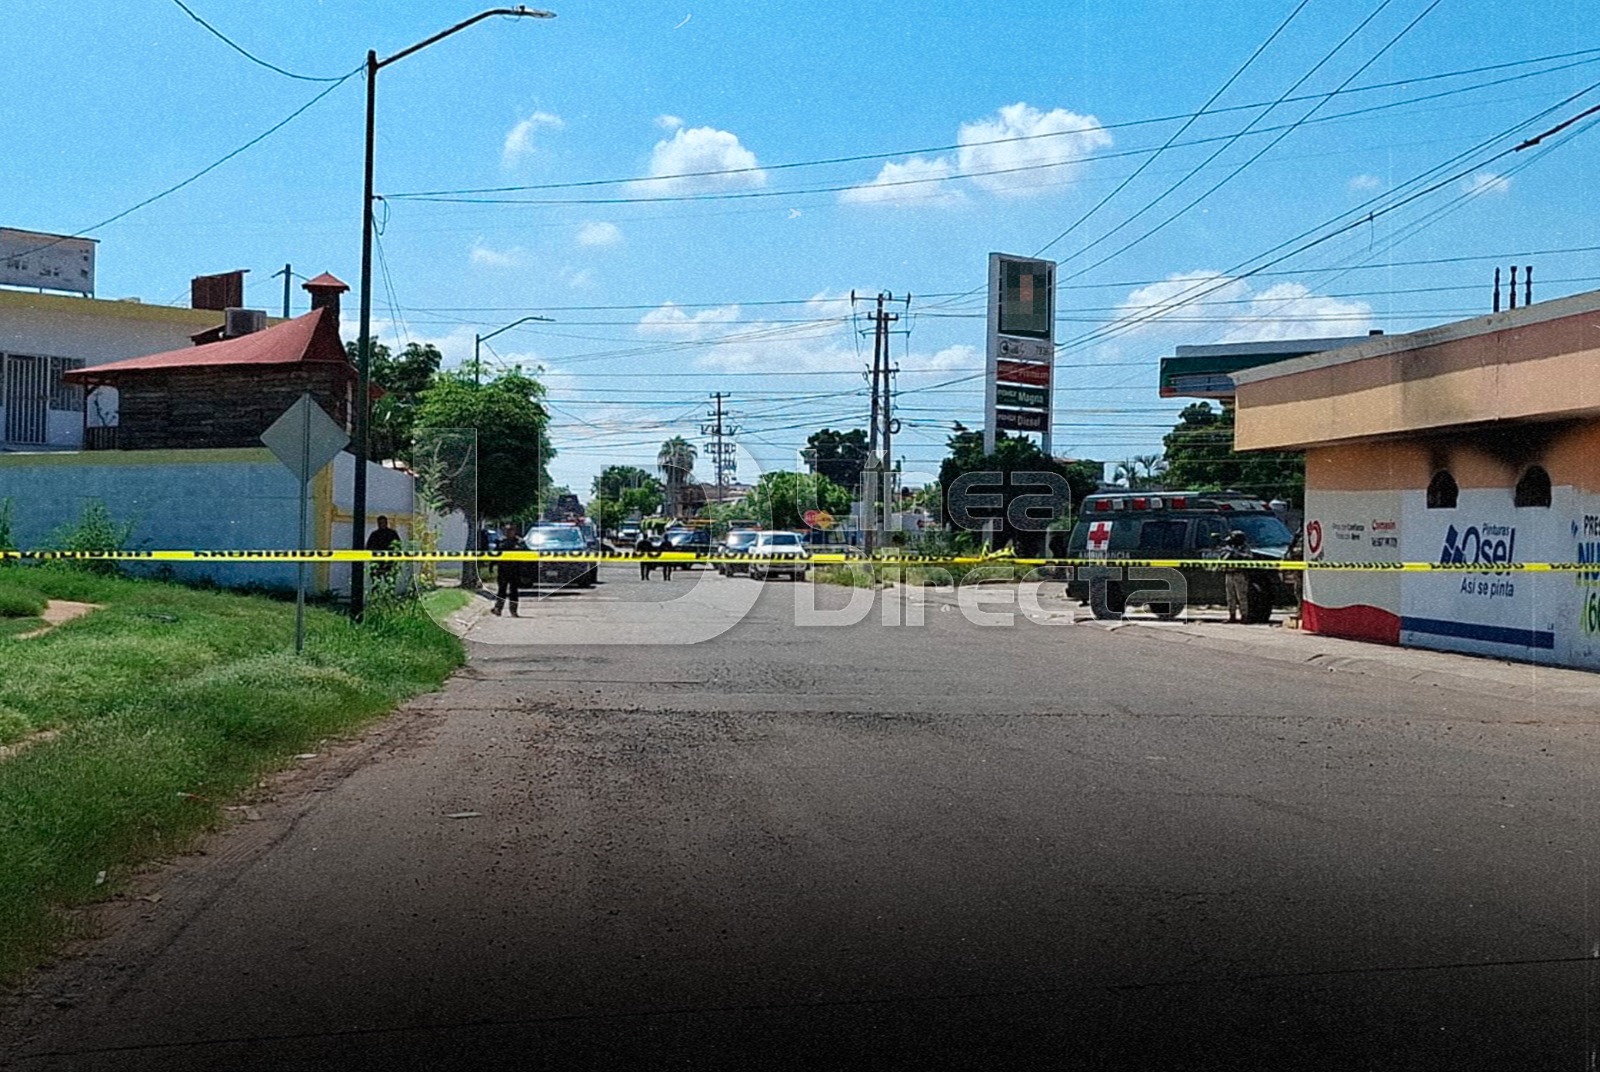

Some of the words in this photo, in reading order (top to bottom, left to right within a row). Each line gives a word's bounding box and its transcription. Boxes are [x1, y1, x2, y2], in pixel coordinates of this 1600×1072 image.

[1018, 390, 1044, 405] Magna
[1017, 414, 1041, 428] Diesel
[1482, 522, 1510, 536] Pinturas
[1462, 526, 1516, 576] Osel
[1478, 581, 1489, 596] se
[1490, 579, 1515, 600] pinta
